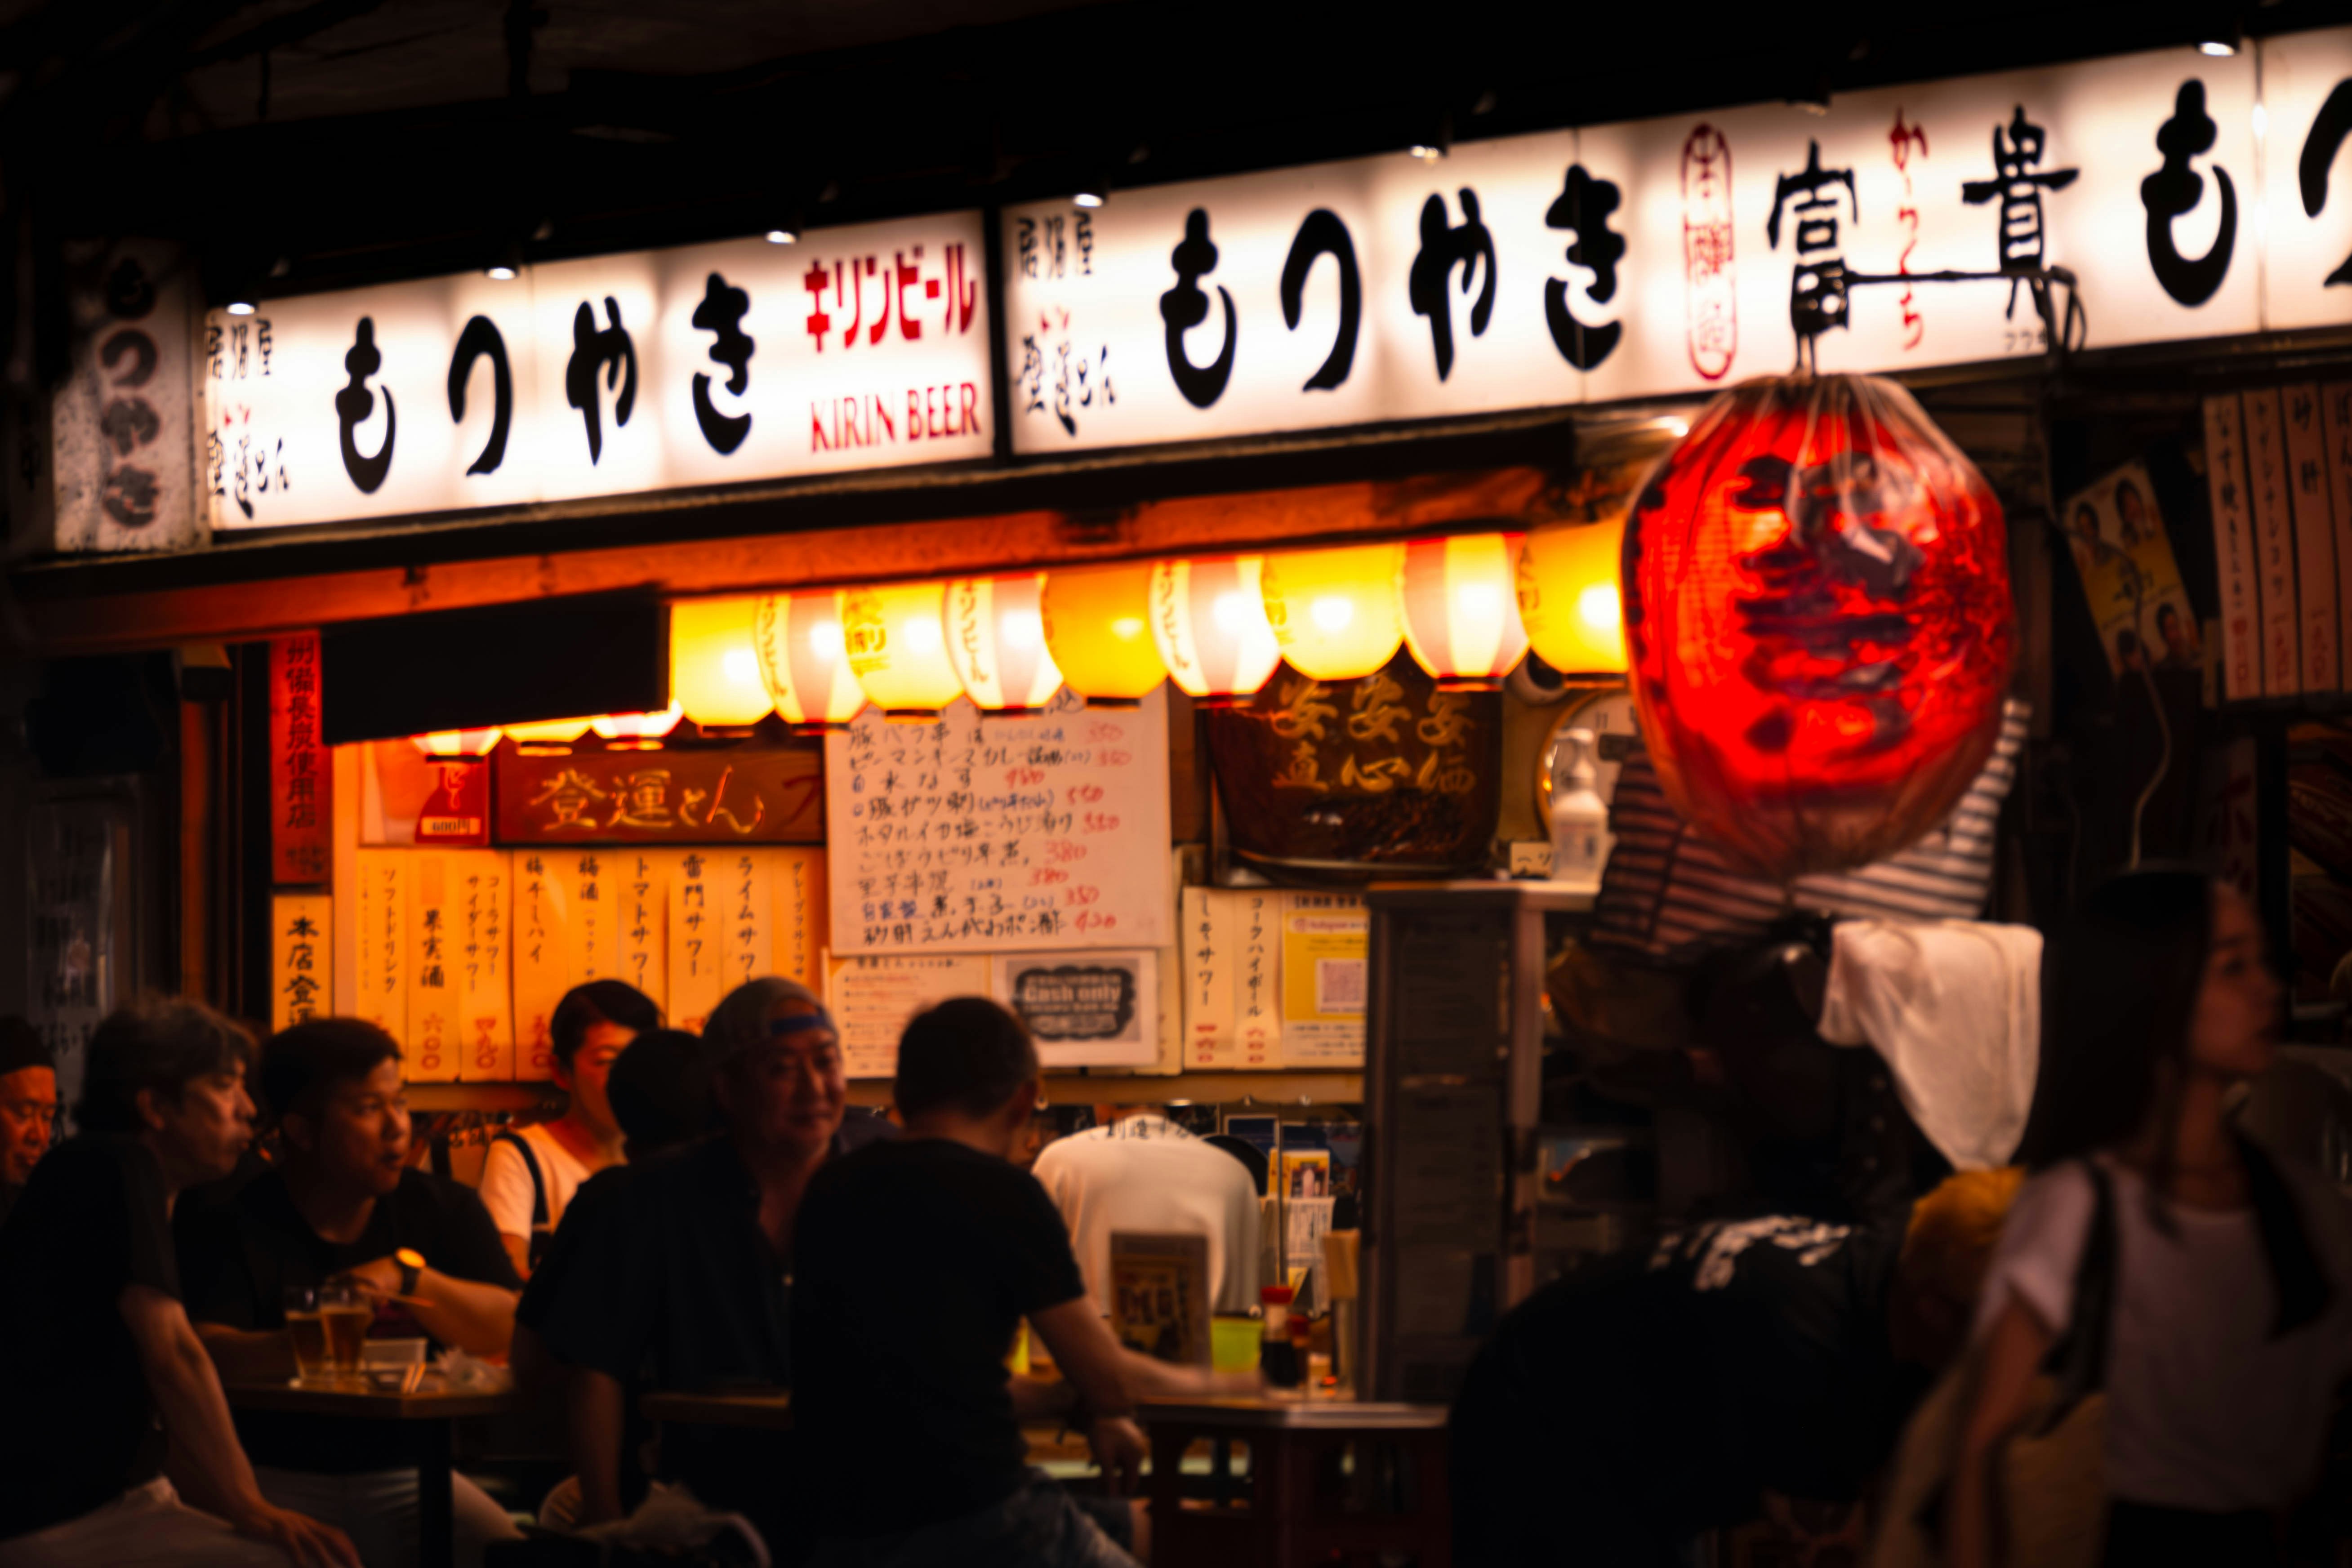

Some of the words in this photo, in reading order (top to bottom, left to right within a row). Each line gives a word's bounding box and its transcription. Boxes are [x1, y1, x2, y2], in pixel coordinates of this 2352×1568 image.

[804, 242, 976, 353] キリンビール
[1159, 164, 1626, 409] もつやき
[334, 271, 756, 494] もつやき
[811, 392, 895, 453] KIRIN
[906, 382, 981, 441] BEER
[531, 763, 765, 834] 登運とん
